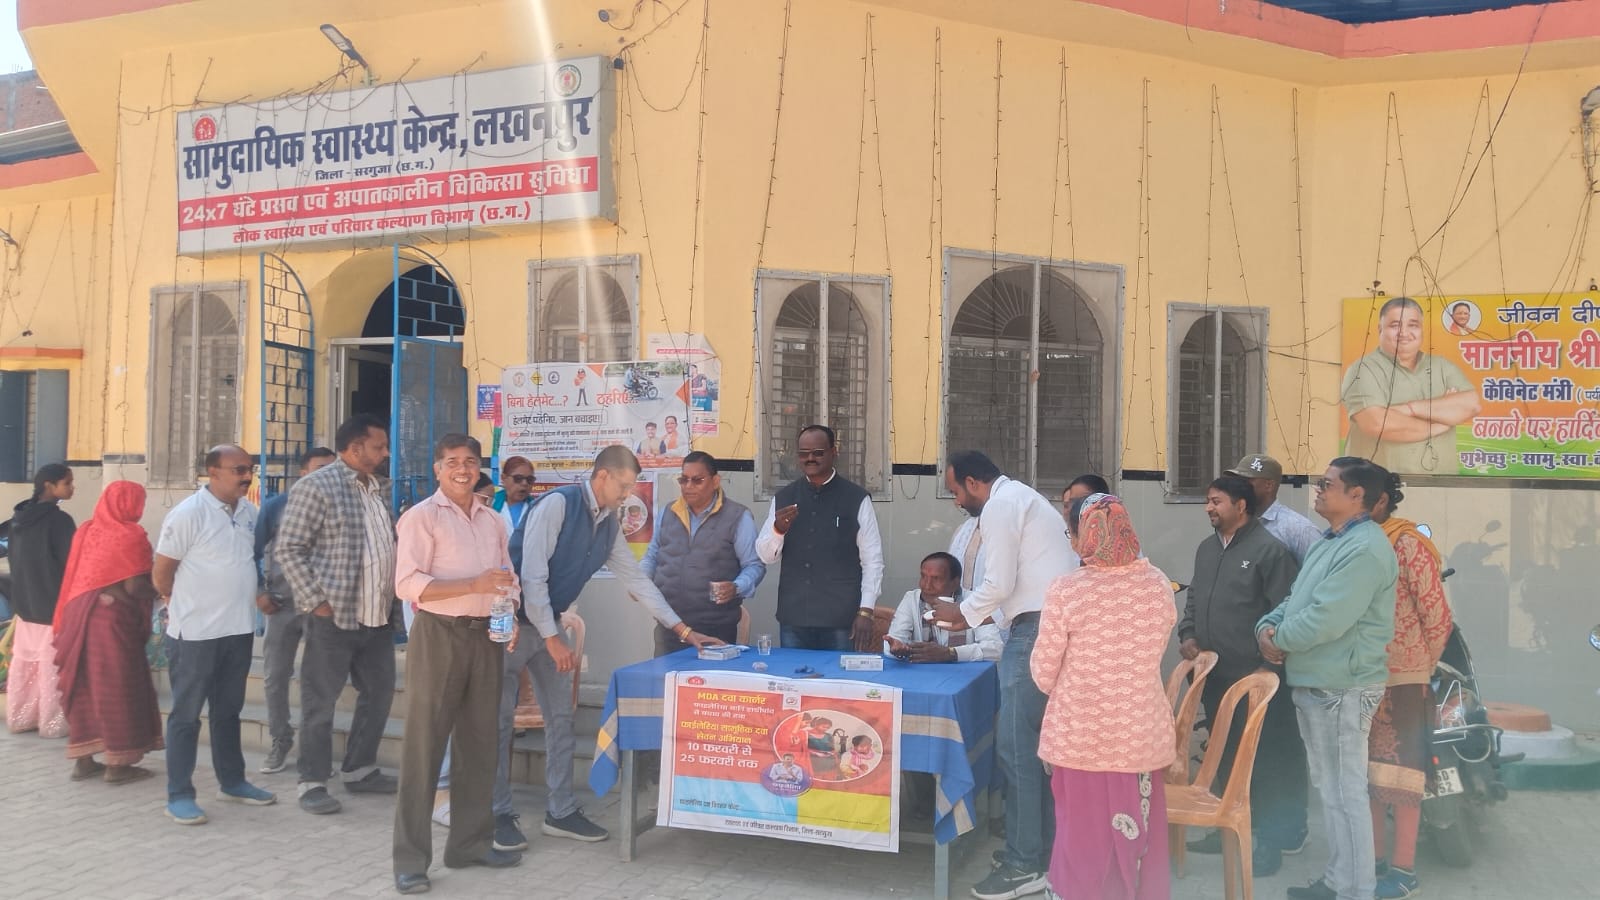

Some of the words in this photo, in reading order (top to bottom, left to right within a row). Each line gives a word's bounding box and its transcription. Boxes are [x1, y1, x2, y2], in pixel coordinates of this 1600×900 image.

[183, 125, 306, 190] सामुदायिक
[311, 119, 398, 165] स्वास्थ्य
[472, 96, 593, 152] लखनपुर
[315, 169, 343, 181] जिला
[354, 164, 392, 178] सरगुजा
[183, 202, 228, 224] 24x7
[260, 195, 300, 216] प्रसव
[303, 187, 330, 211] एवं
[449, 171, 525, 197] चिकित्सा
[528, 165, 591, 195] सुविधा
[233, 228, 260, 243] लोक
[264, 224, 305, 241] स्वास्थ्य
[309, 219, 329, 236] एवं
[332, 217, 374, 234] परिवार
[376, 213, 427, 230] कल्याण
[431, 208, 475, 225] विभाग
[1498, 301, 1560, 323] जीवन
[1571, 299, 1600, 324] दी
[1459, 330, 1560, 369] माननीय
[1483, 379, 1538, 401] कैबिनेट
[1542, 379, 1573, 401] मंत्री
[507, 393, 525, 409] बिना
[1472, 410, 1521, 439] बनने
[1527, 418, 1551, 439] पर
[697, 692, 719, 701] MDA
[721, 694, 737, 703] दवा
[718, 734, 752, 744] अभियान
[755, 727, 769, 736] दवा
[687, 742, 700, 751] 10
[703, 743, 739, 755] फरवरी
[742, 744, 752, 756] से
[680, 753, 695, 763] 25
[699, 755, 735, 767] फरवरी
[737, 759, 760, 769] तक
